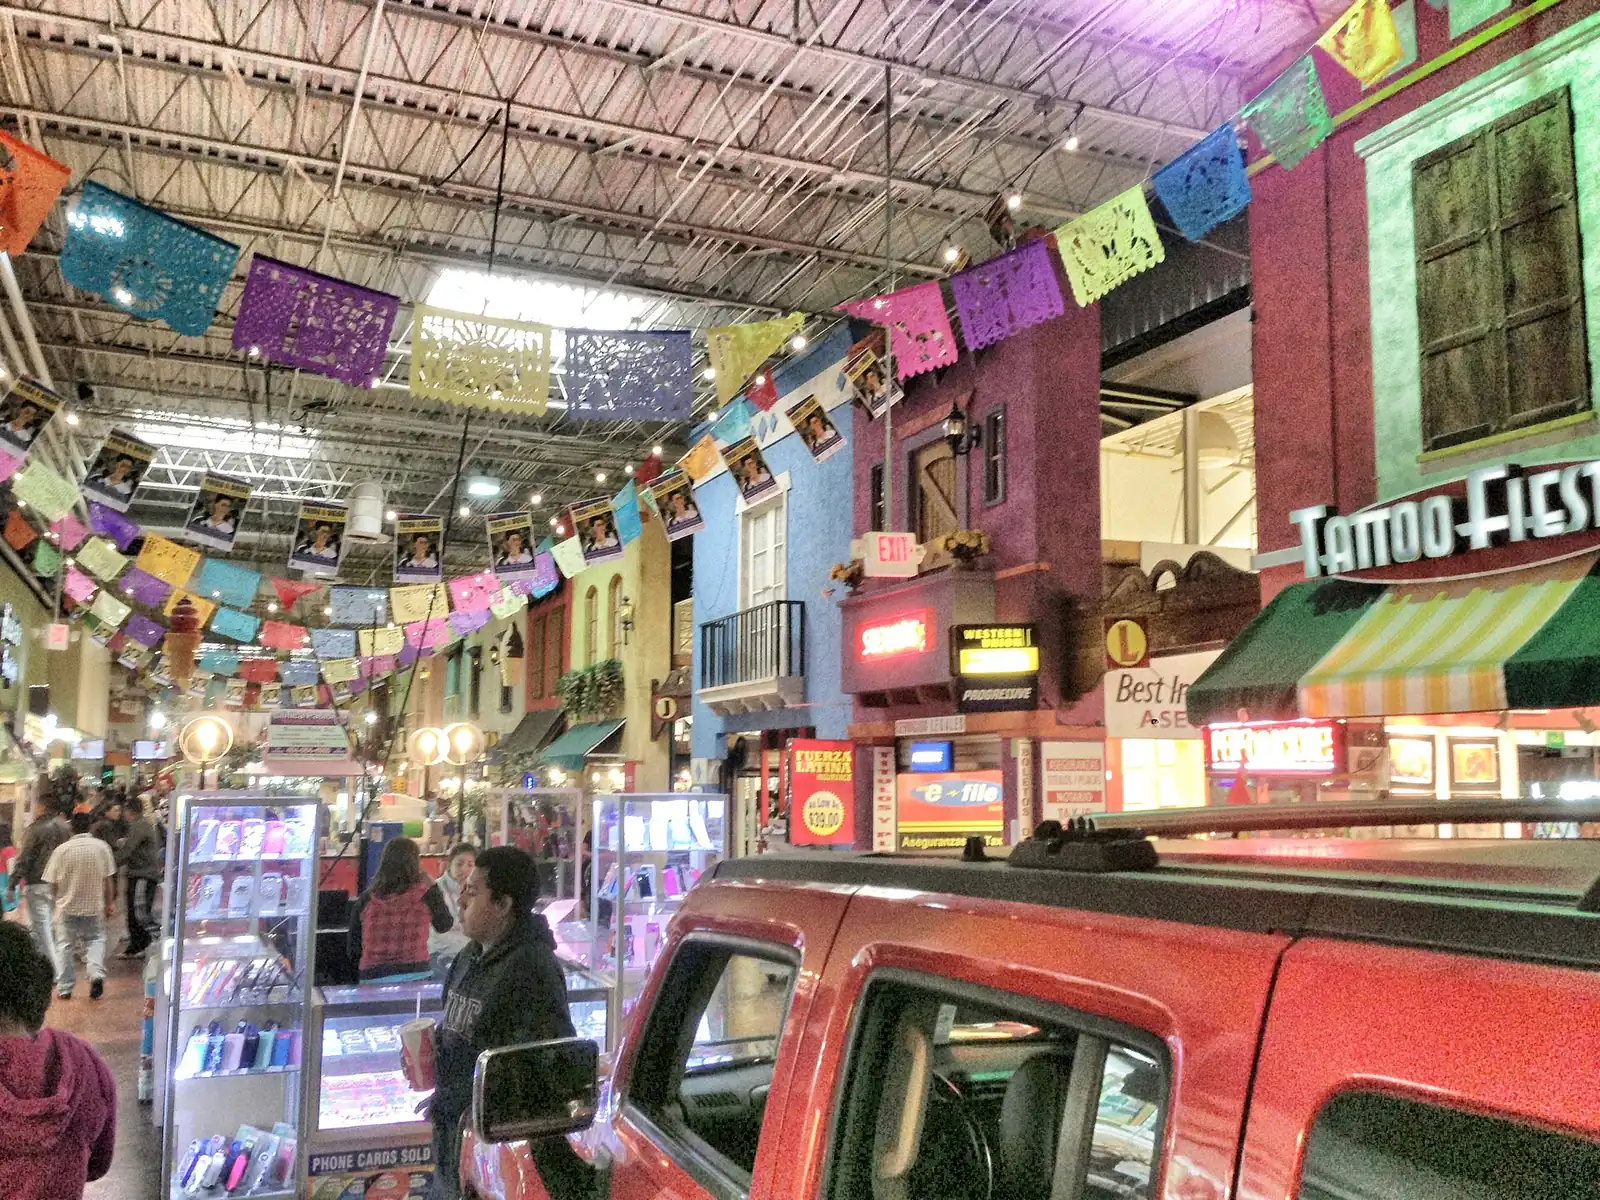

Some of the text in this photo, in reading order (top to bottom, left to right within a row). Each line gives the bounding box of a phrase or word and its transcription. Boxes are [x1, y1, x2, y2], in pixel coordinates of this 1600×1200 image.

[1289, 495, 1455, 578] TATTOO
[879, 536, 907, 561] EXIT
[963, 627, 1023, 640] WESTERN
[1118, 623, 1140, 662] L
[1116, 674, 1164, 704] Best
[662, 700, 670, 717] J
[796, 751, 852, 762] FUERZA
[796, 761, 852, 773] LATINA
[809, 812, 839, 829] $39.00
[902, 836, 967, 850] Aseguranzas
[312, 1147, 431, 1172] PHONE CARDS SOLD
